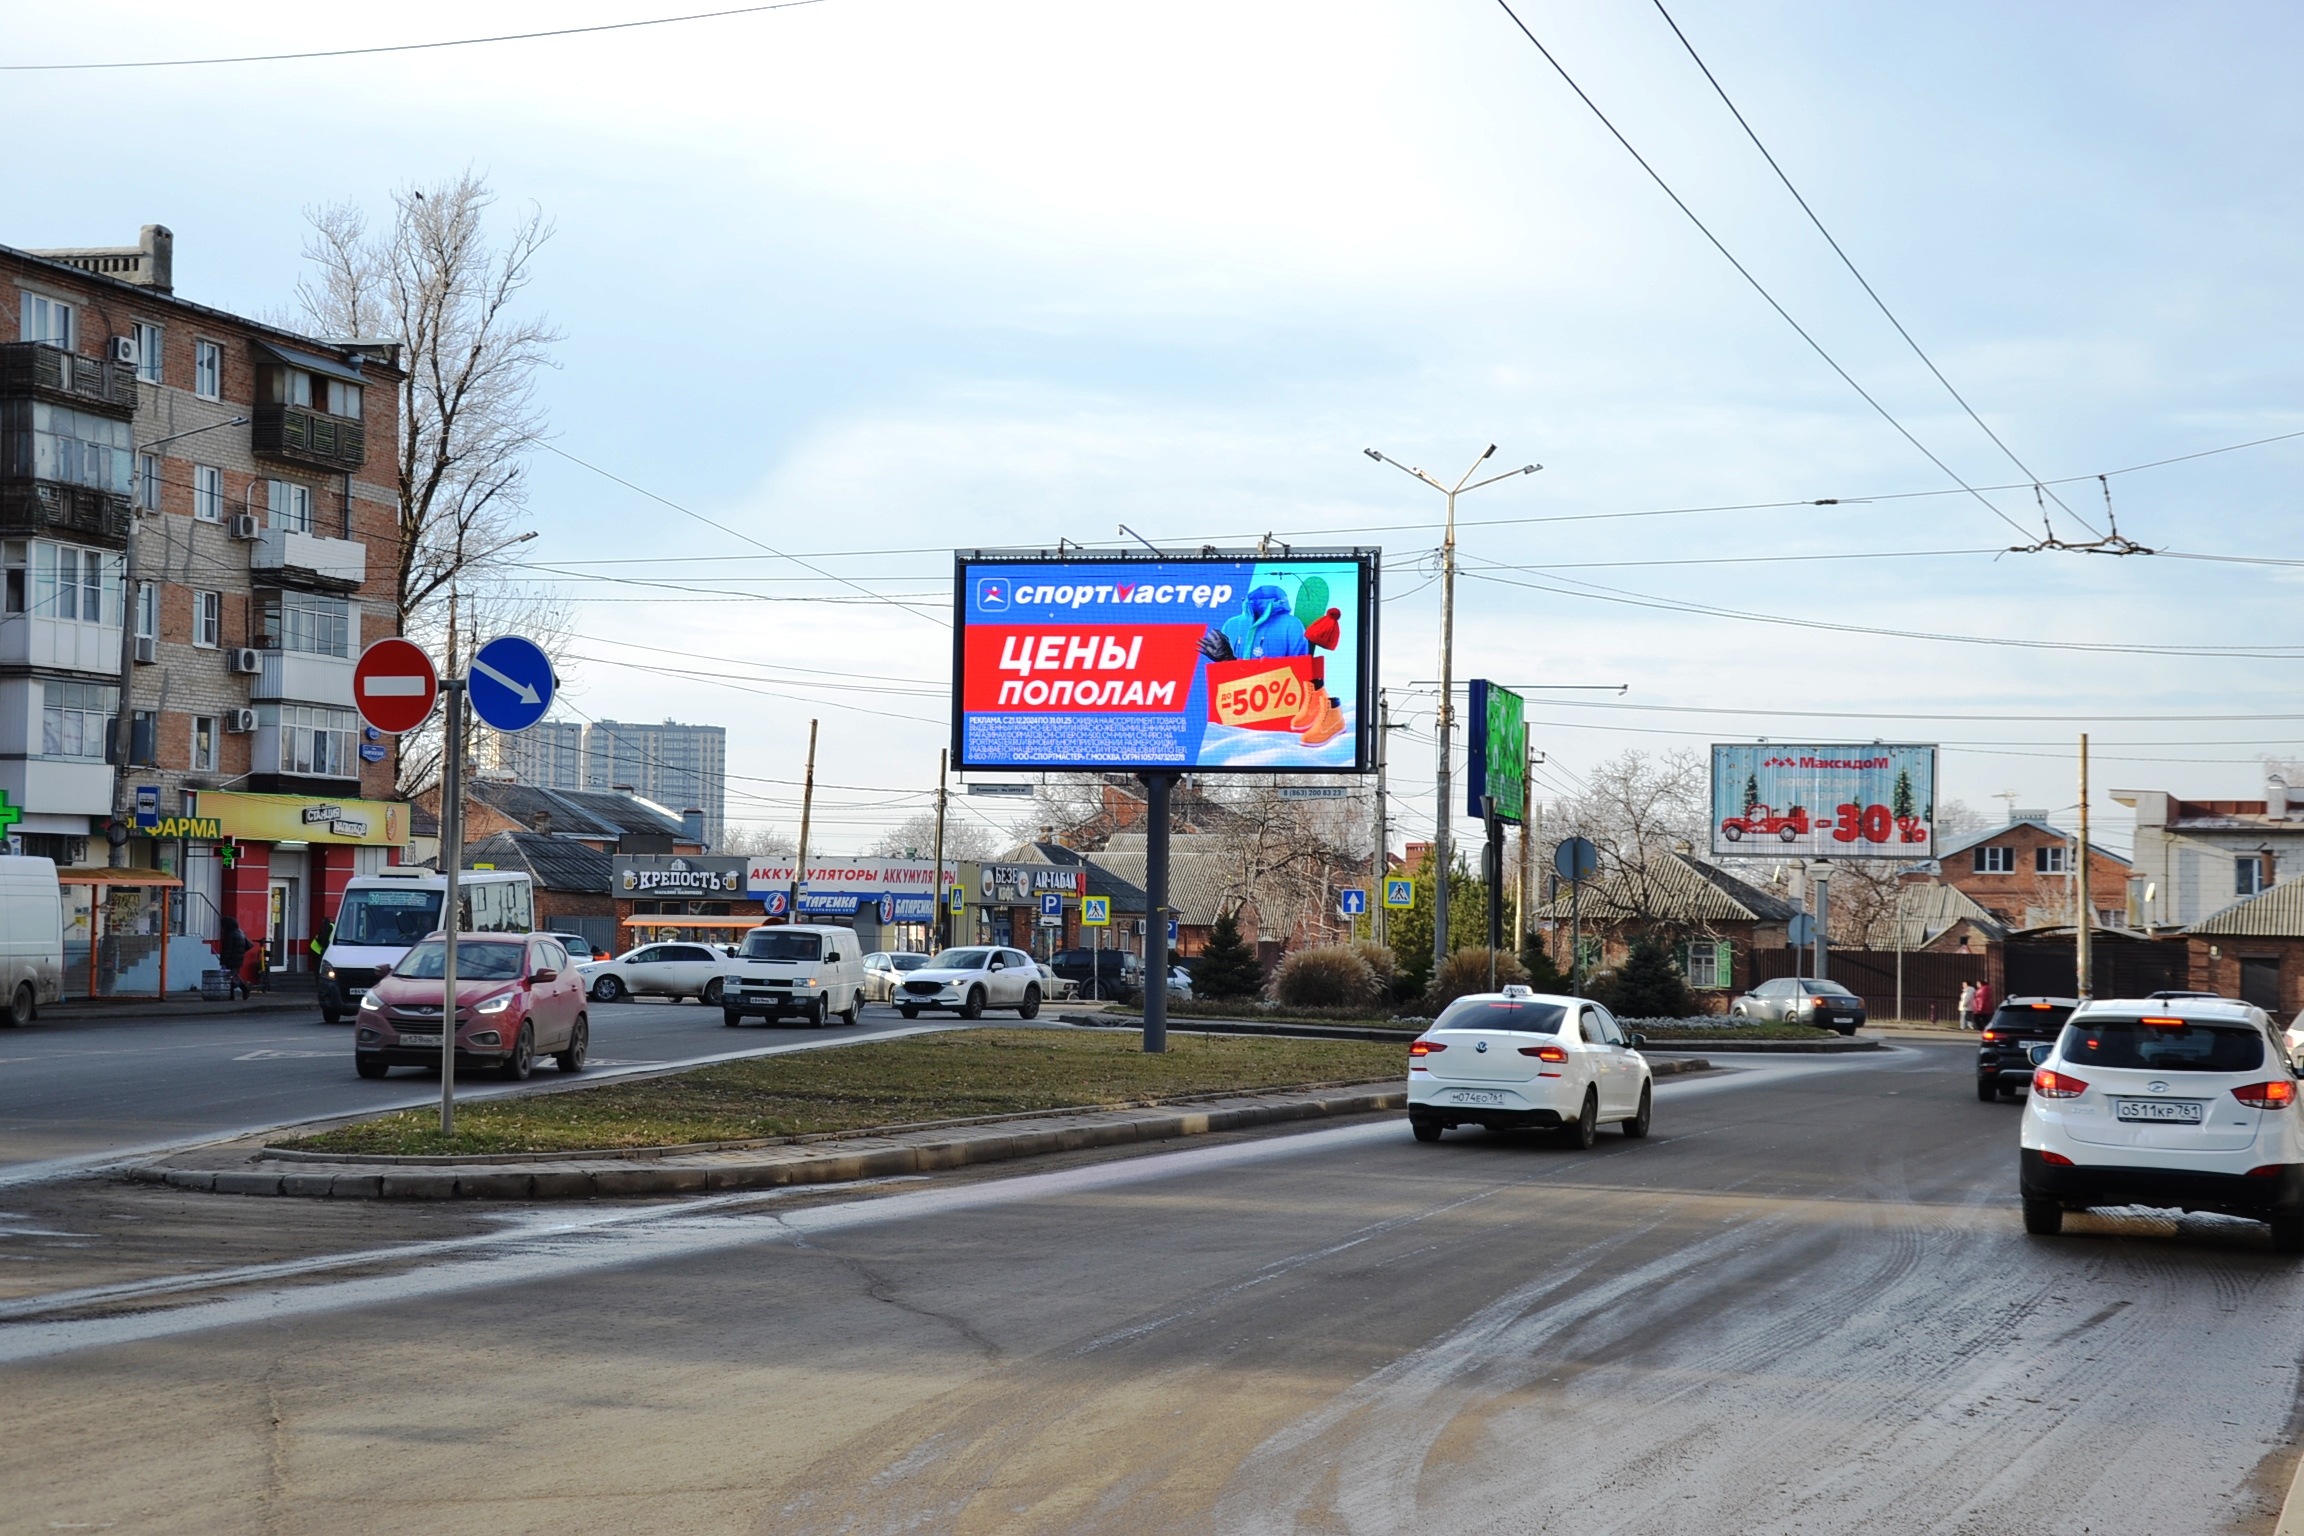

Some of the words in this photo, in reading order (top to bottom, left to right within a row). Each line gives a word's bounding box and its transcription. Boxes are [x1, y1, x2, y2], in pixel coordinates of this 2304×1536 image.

[998, 635, 1144, 677] ЦЕНЫ
[997, 679, 1177, 706] ПОПОЛАМ
[1221, 677, 1297, 716] -50%
[1012, 752, 1030, 760] ООО
[1799, 756, 1889, 770] МаксидоМ
[1283, 789, 1288, 797] 8
[1289, 789, 1308, 797] (863)
[1308, 789, 1322, 797] 200
[1322, 789, 1332, 797] 83
[1332, 789, 1342, 797] 23
[306, 807, 341, 821] СТАНЦИЯ
[1813, 803, 1928, 844] -30%
[638, 871, 721, 891] КРЕПОСТЬ
[750, 868, 878, 881] АККУУЛЯТОРЫ
[882, 868, 957, 885] АККУМУЛЯРЫ
[994, 866, 1018, 884] БЕЗЕ
[805, 895, 858, 908] ТАРЕЙКА
[1045, 895, 1058, 913] P
[1452, 1092, 1488, 1103] М074ЕО
[1489, 1093, 1503, 1101] 761
[2121, 1103, 2174, 1118] О511КР
[2177, 1105, 2199, 1116] 761
